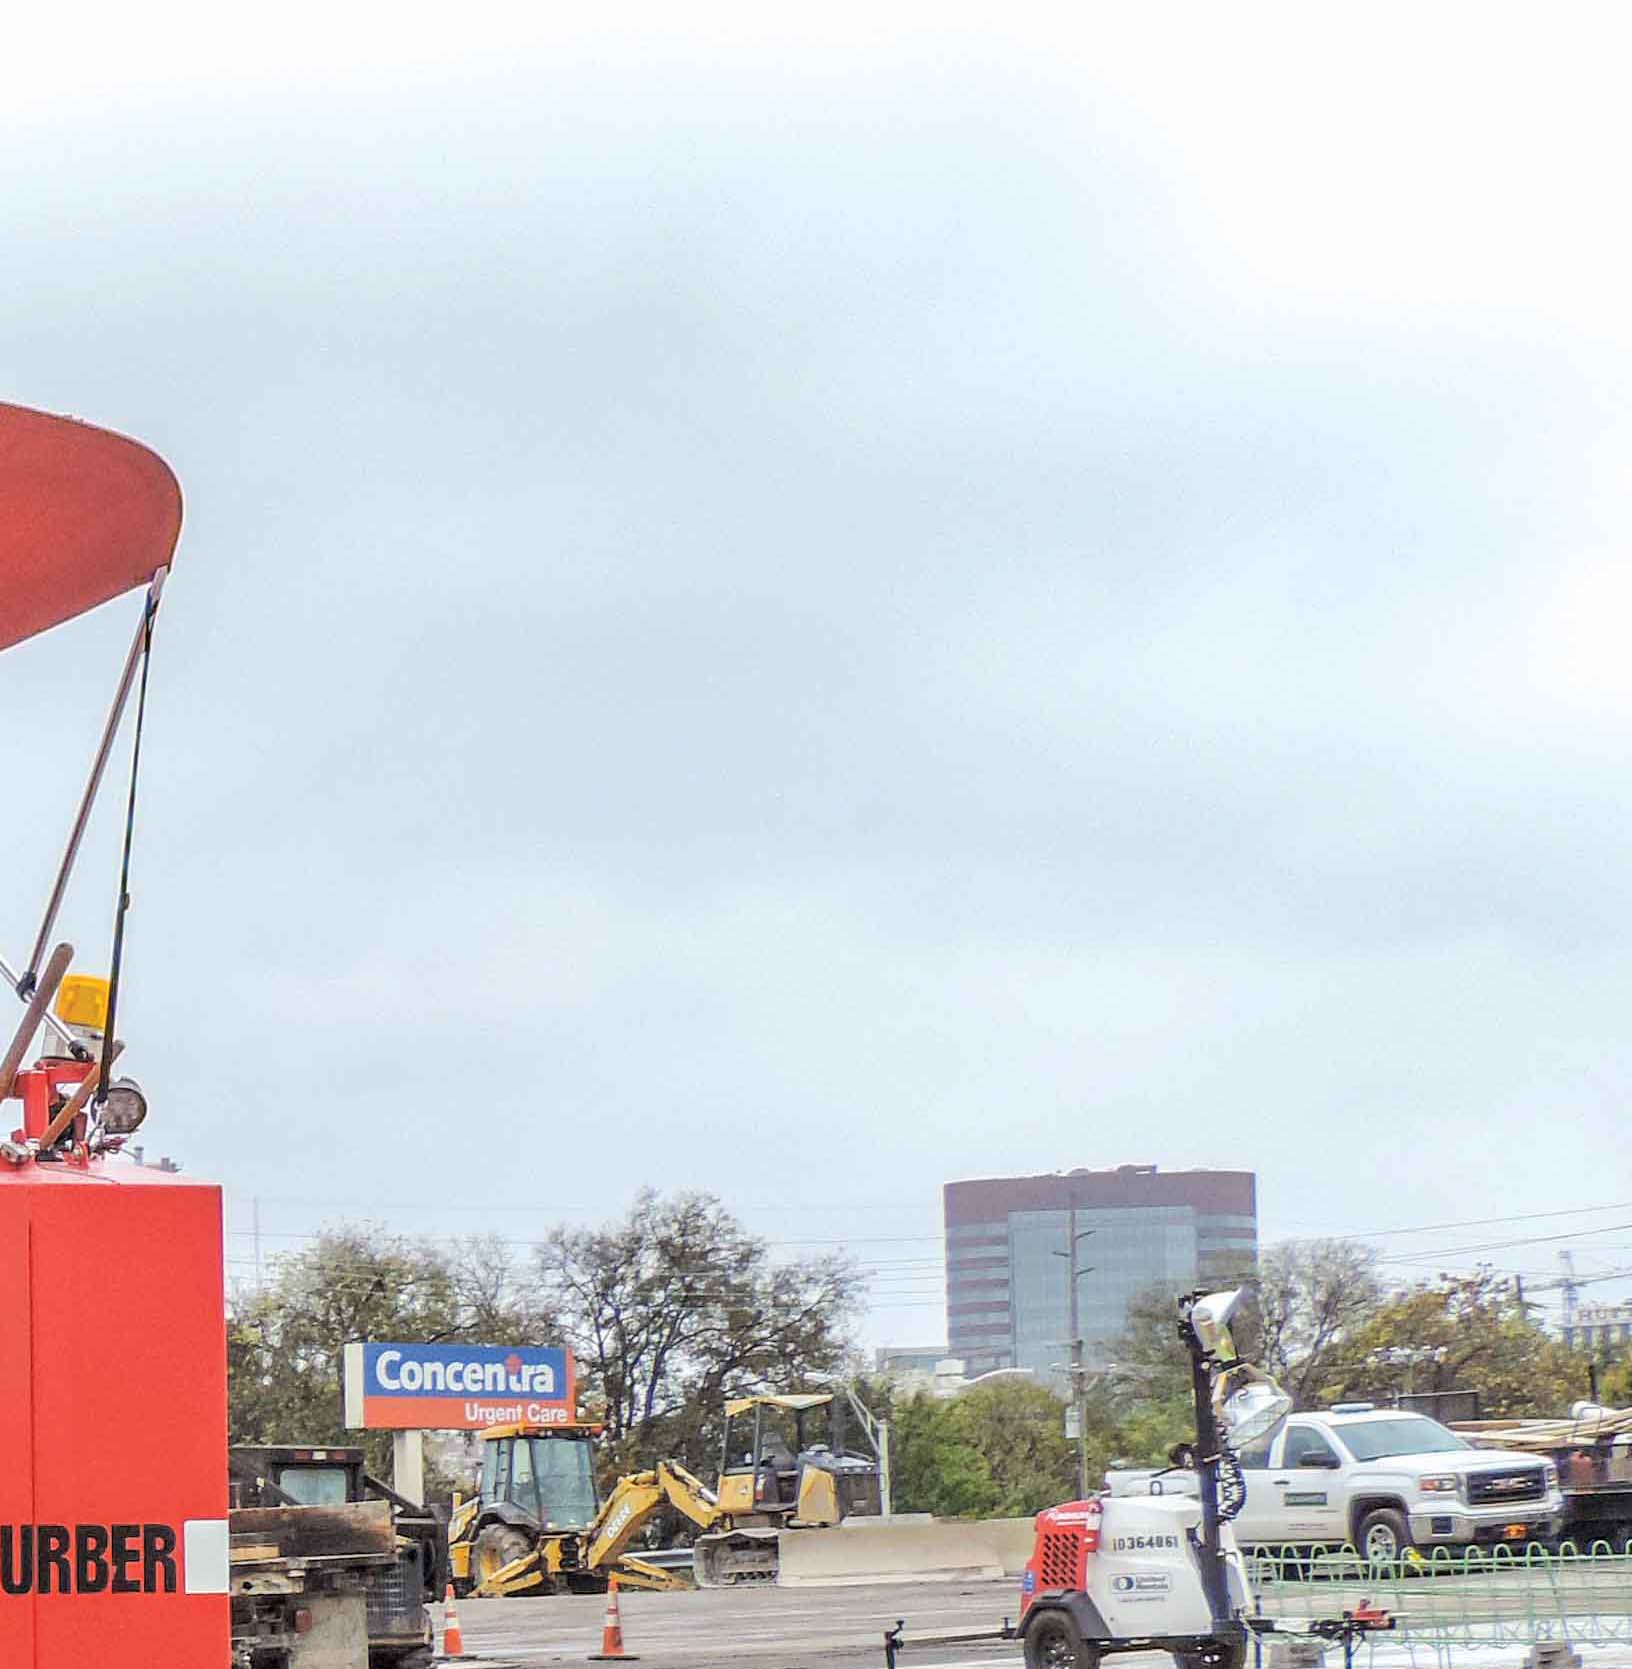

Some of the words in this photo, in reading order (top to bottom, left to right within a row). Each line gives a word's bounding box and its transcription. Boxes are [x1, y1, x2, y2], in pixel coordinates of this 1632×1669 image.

[375, 1350, 554, 1393] Concentra
[465, 1402, 523, 1423] Urgent
[527, 1403, 568, 1423] Care
